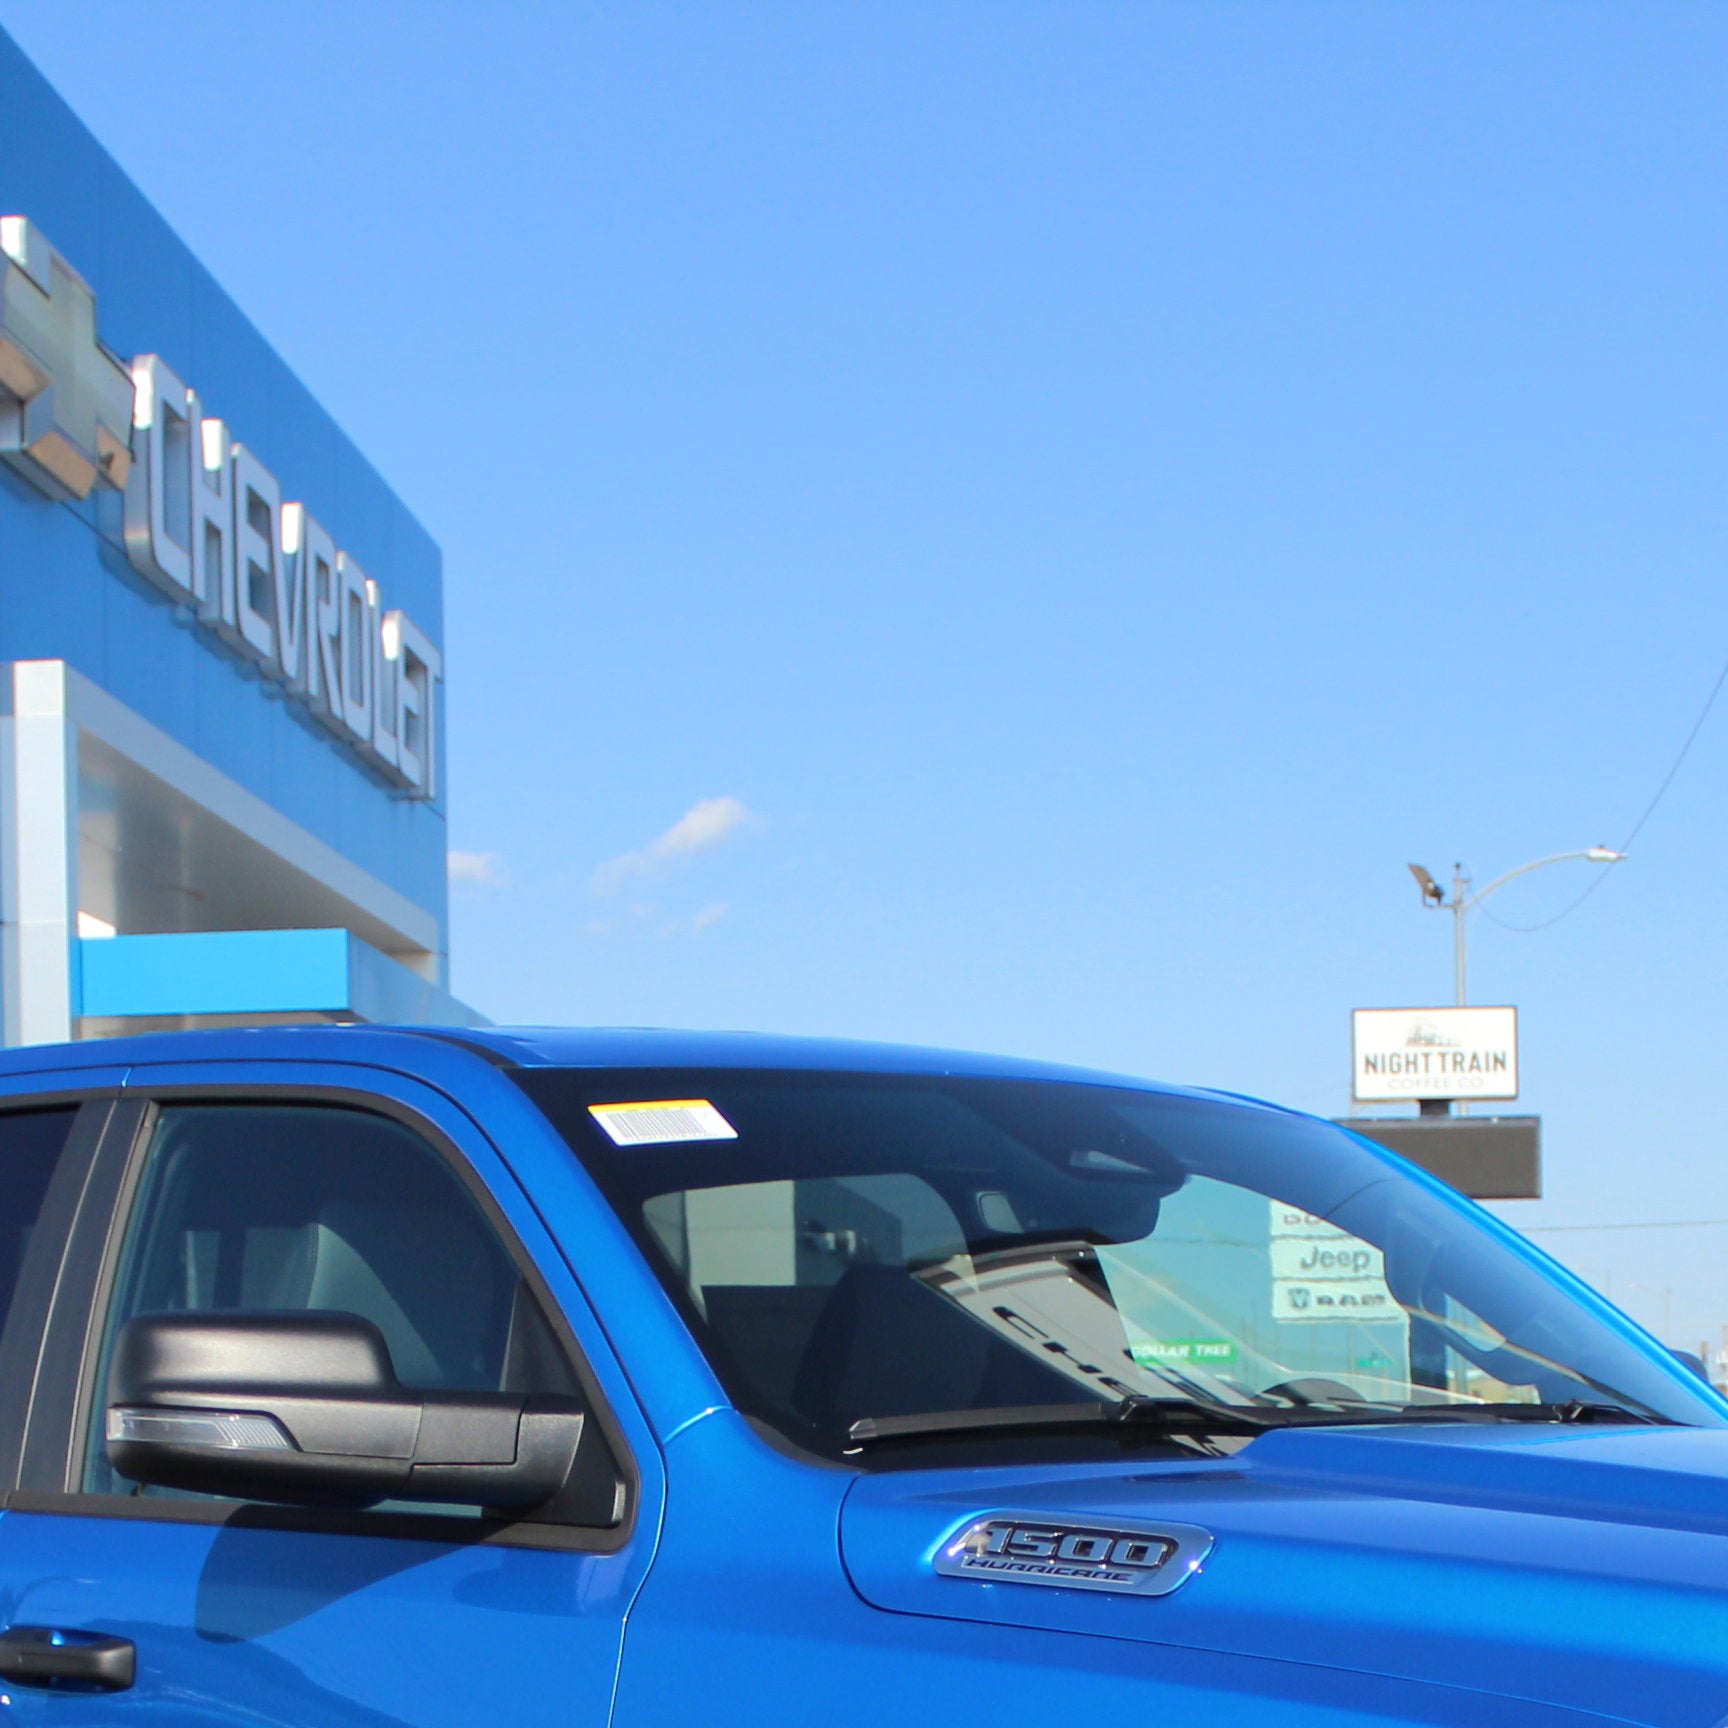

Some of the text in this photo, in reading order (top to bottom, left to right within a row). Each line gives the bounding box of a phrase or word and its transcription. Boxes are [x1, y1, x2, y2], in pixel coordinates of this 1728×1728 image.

[125, 352, 444, 801] CHEVROLET
[1364, 1050, 1507, 1075] NIGHT TRAIN
[1388, 1076, 1484, 1090] COFFEE CO
[1300, 1246, 1371, 1273] Jeep
[975, 1526, 1168, 1567] 1500
[966, 1557, 1133, 1582] HURRICANE
